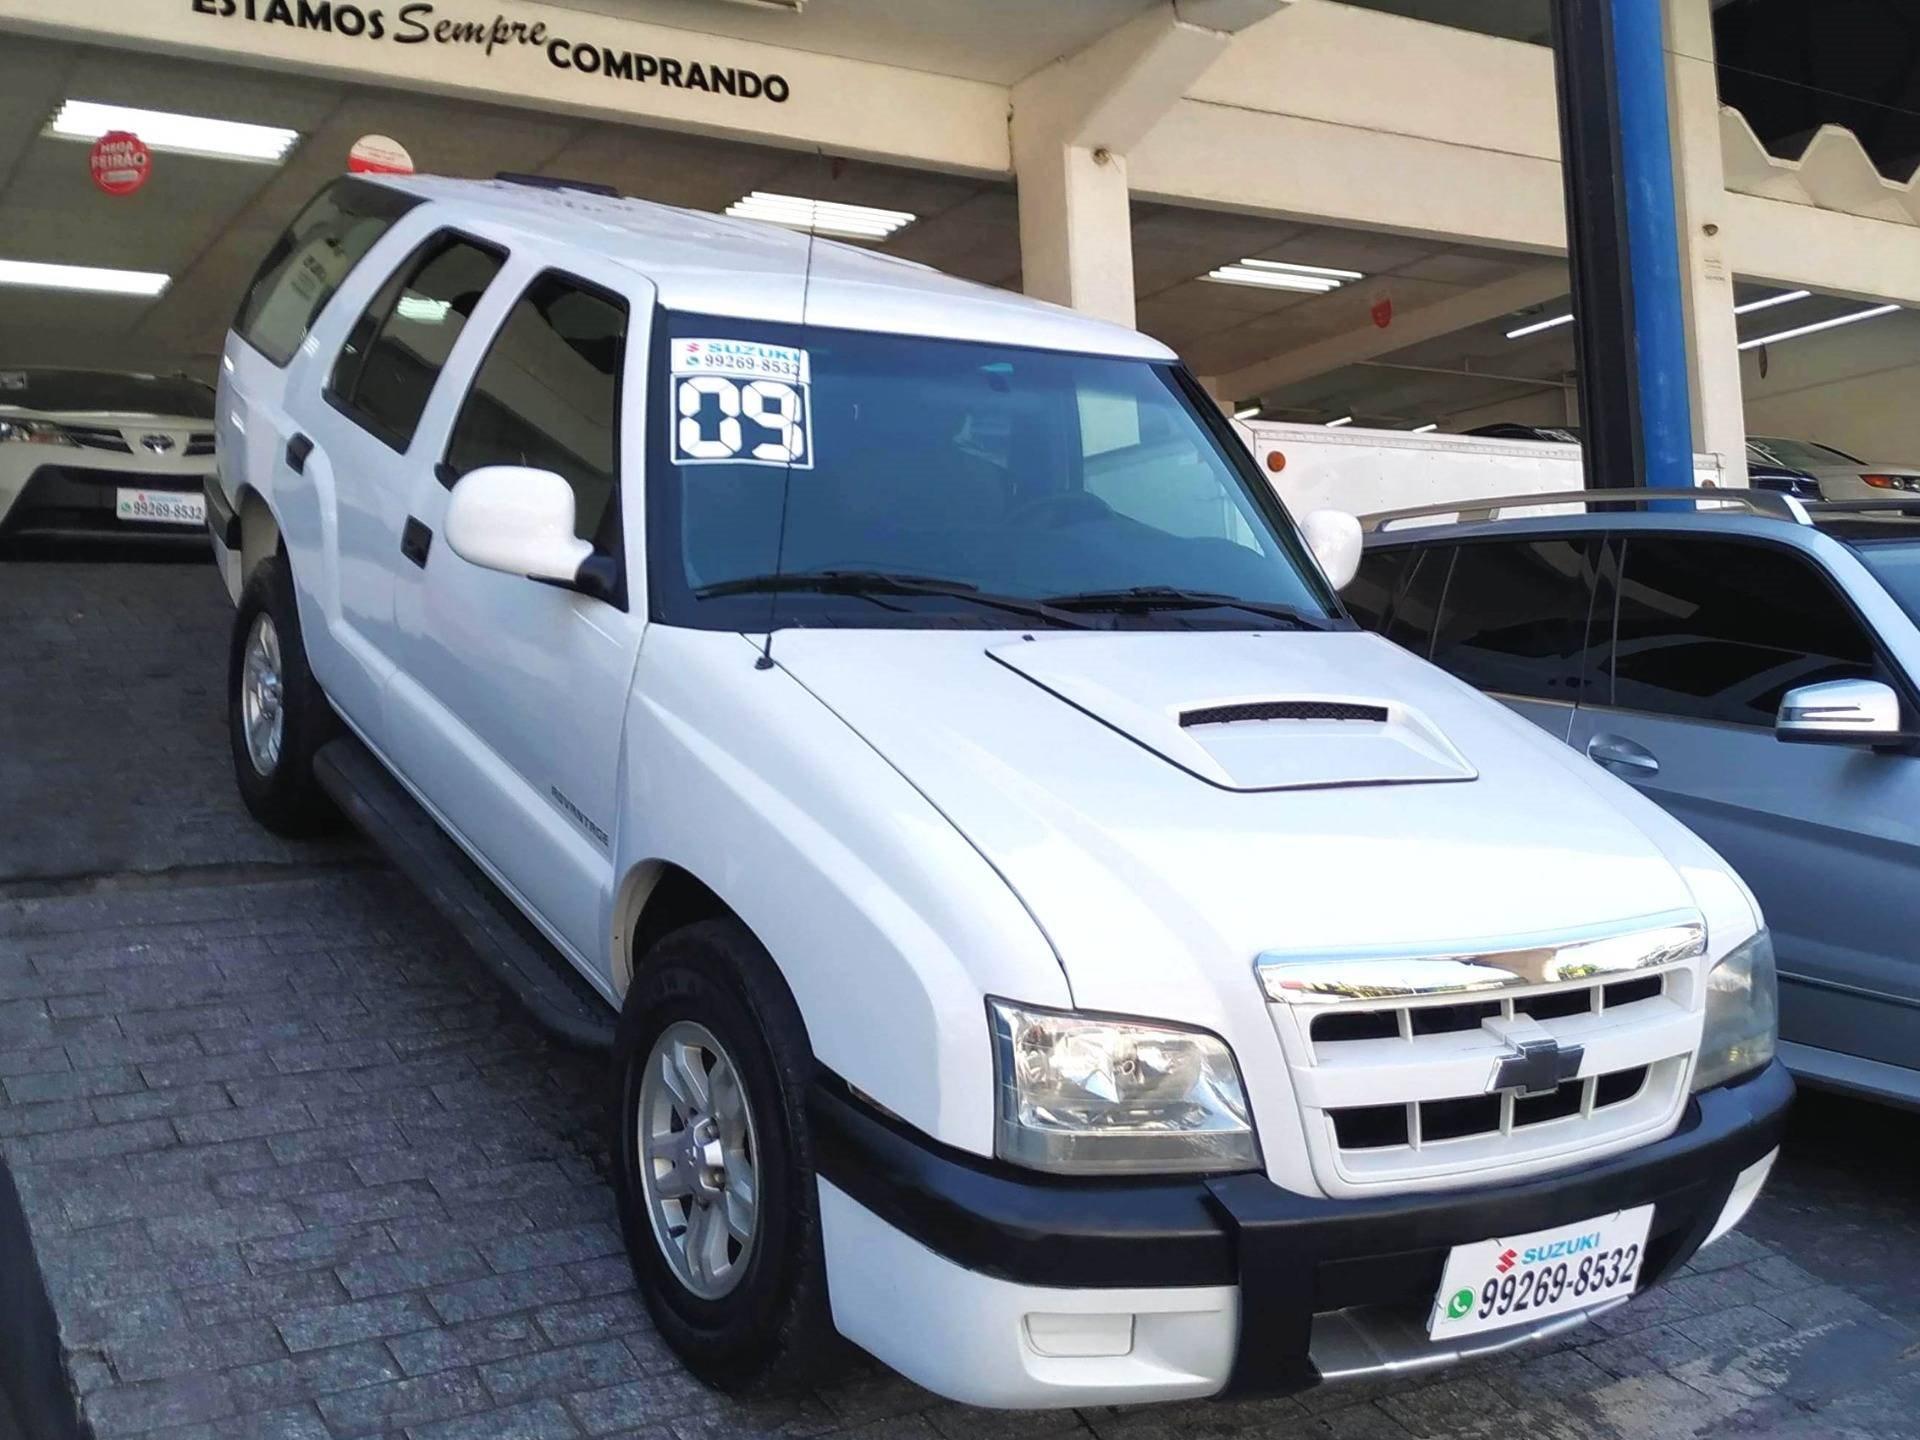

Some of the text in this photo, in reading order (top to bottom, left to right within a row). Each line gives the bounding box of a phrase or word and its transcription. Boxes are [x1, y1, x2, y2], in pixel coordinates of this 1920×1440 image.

[393, 3, 548, 56] Sempre
[546, 39, 790, 103] COMPRANDO
[704, 354, 800, 376] 99269-8532
[708, 343, 800, 361] SUZUKI
[679, 376, 804, 461] 09
[133, 501, 202, 520] 99269-8532
[1521, 1232, 1600, 1265] SUZUKI
[1478, 1243, 1639, 1320] 99269-8532
